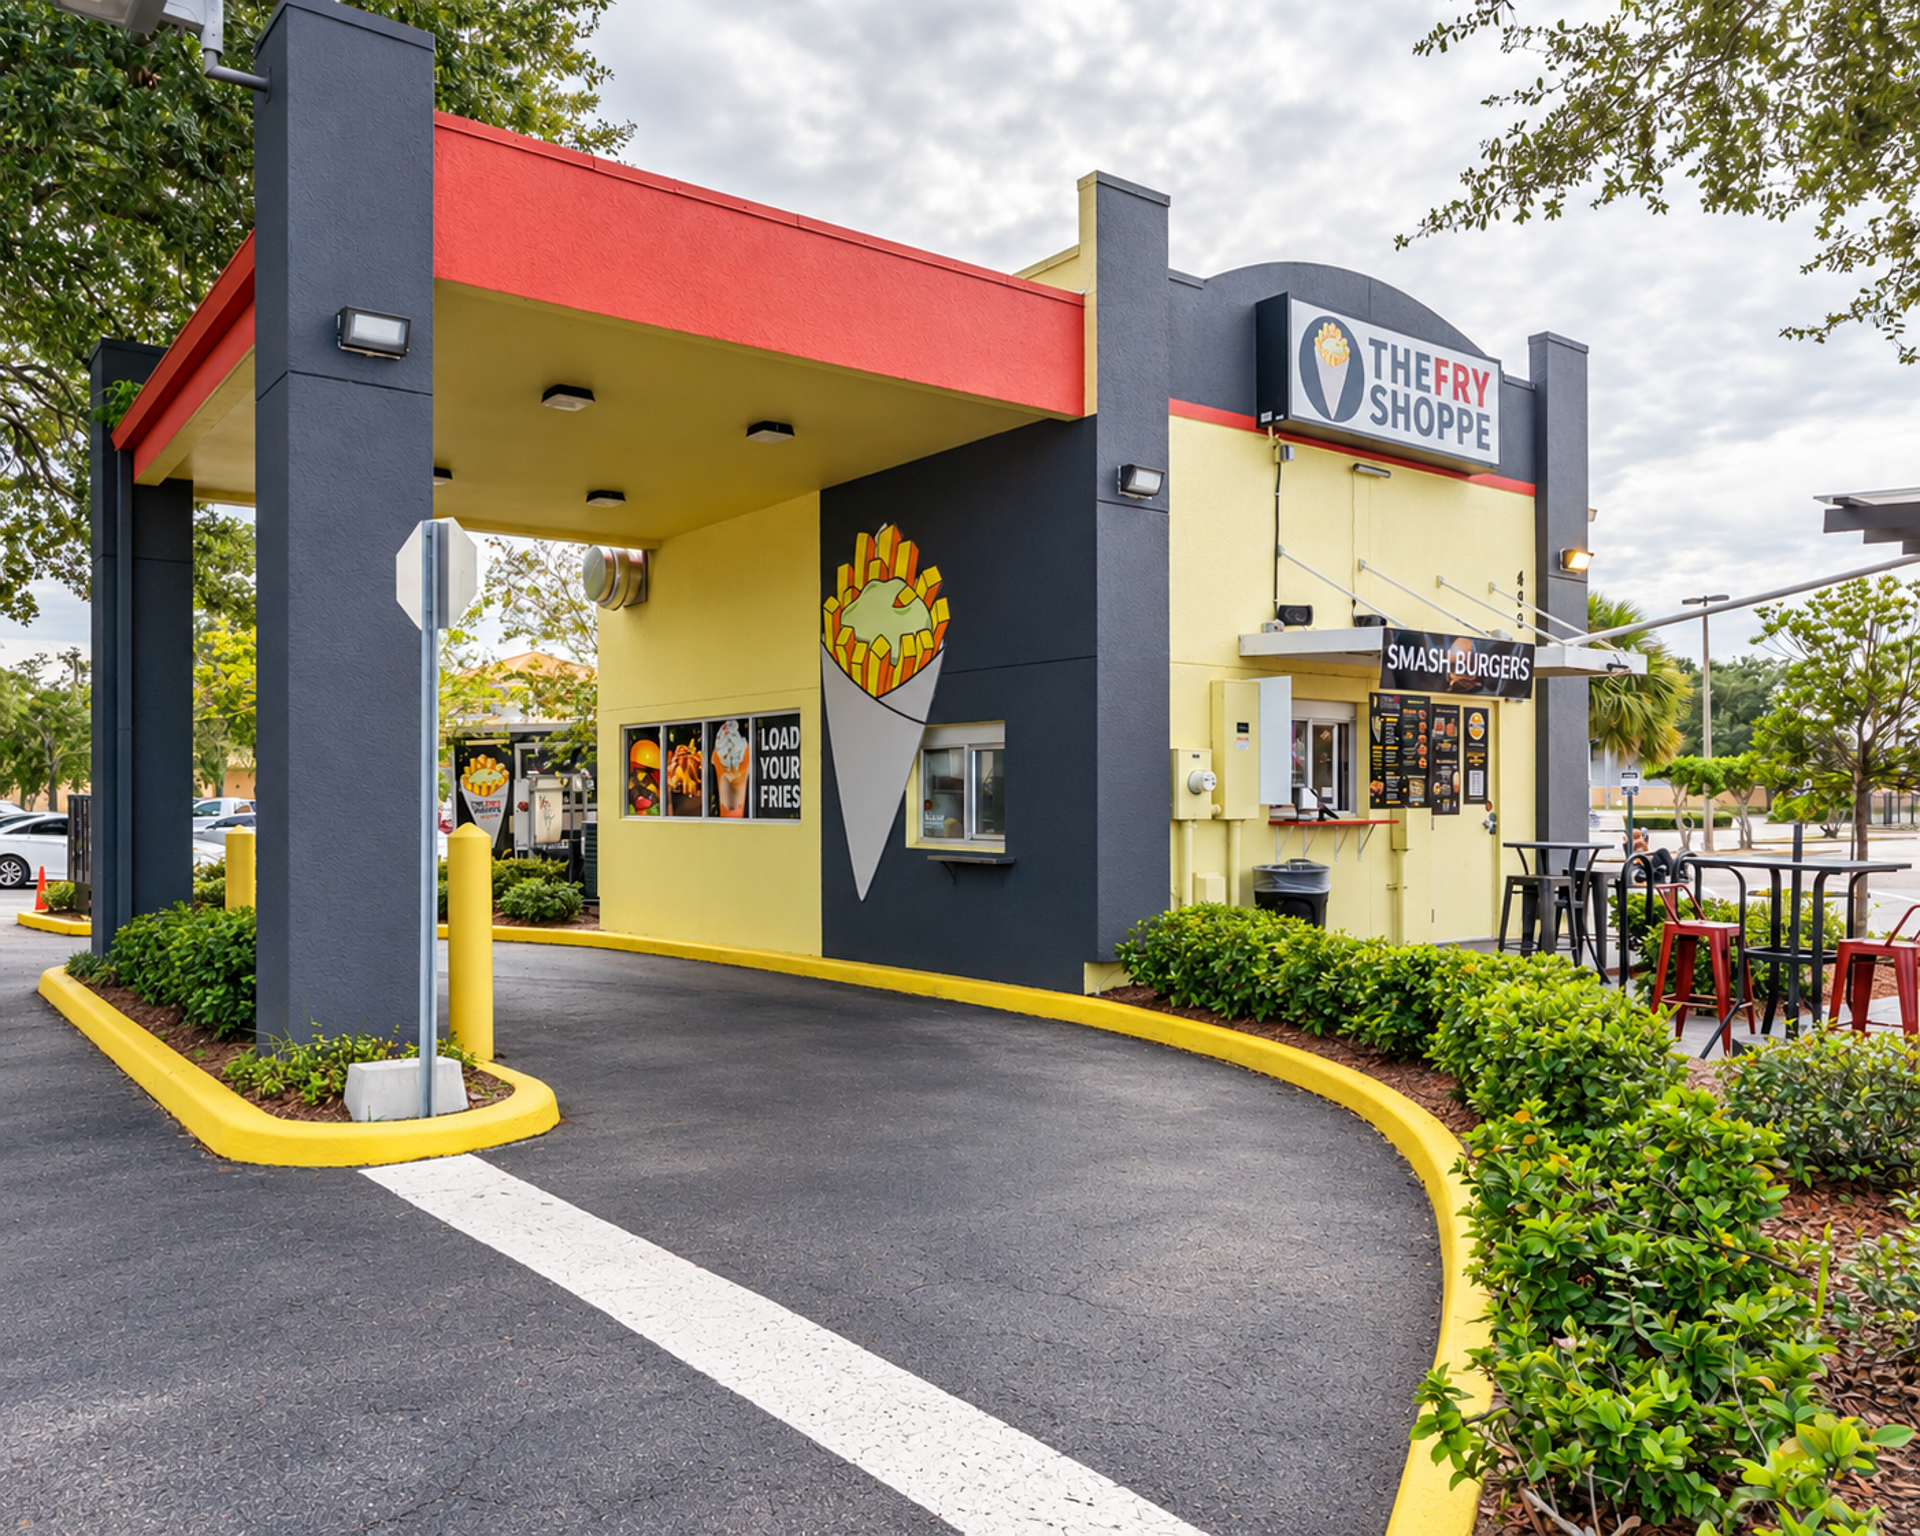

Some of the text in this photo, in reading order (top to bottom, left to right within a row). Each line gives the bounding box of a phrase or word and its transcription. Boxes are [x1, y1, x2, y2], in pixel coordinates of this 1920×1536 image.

[1369, 384, 1491, 452] SHOPPE
[1386, 643, 1530, 681] SMASH BURGERS
[760, 726, 800, 751] LOAD
[760, 756, 800, 780] YOUR
[760, 784, 801, 809] FRIES
